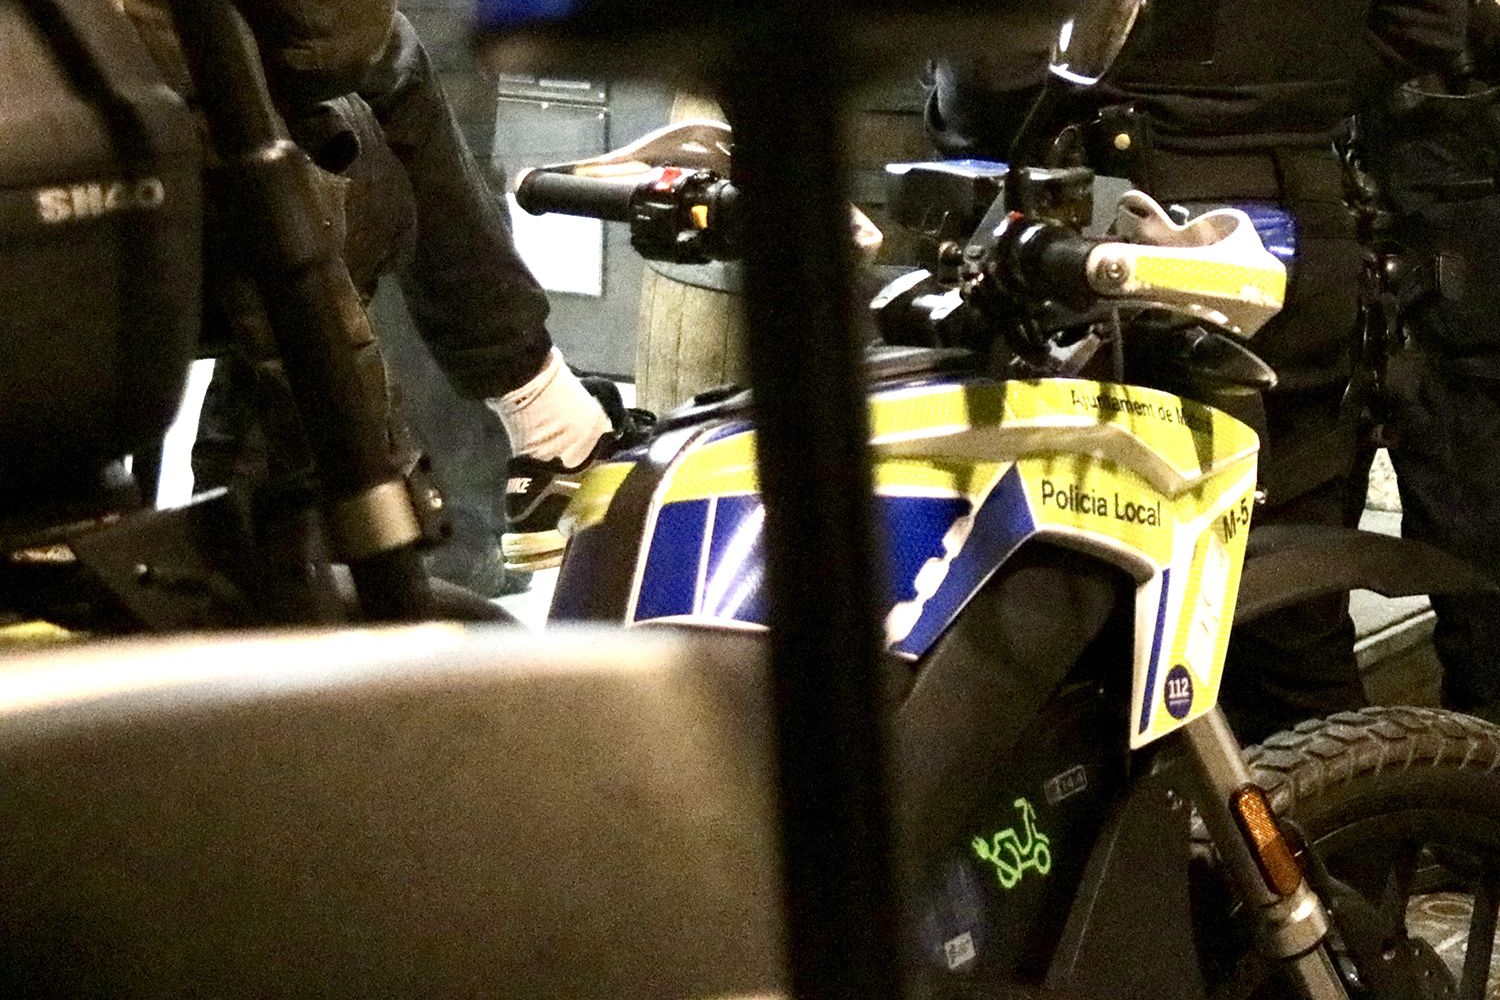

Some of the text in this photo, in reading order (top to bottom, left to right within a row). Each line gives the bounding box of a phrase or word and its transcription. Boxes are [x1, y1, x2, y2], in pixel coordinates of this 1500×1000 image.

[1041, 479, 1161, 527] Policia Local
[1223, 498, 1250, 544] M-5
[1168, 677, 1190, 699] 112
